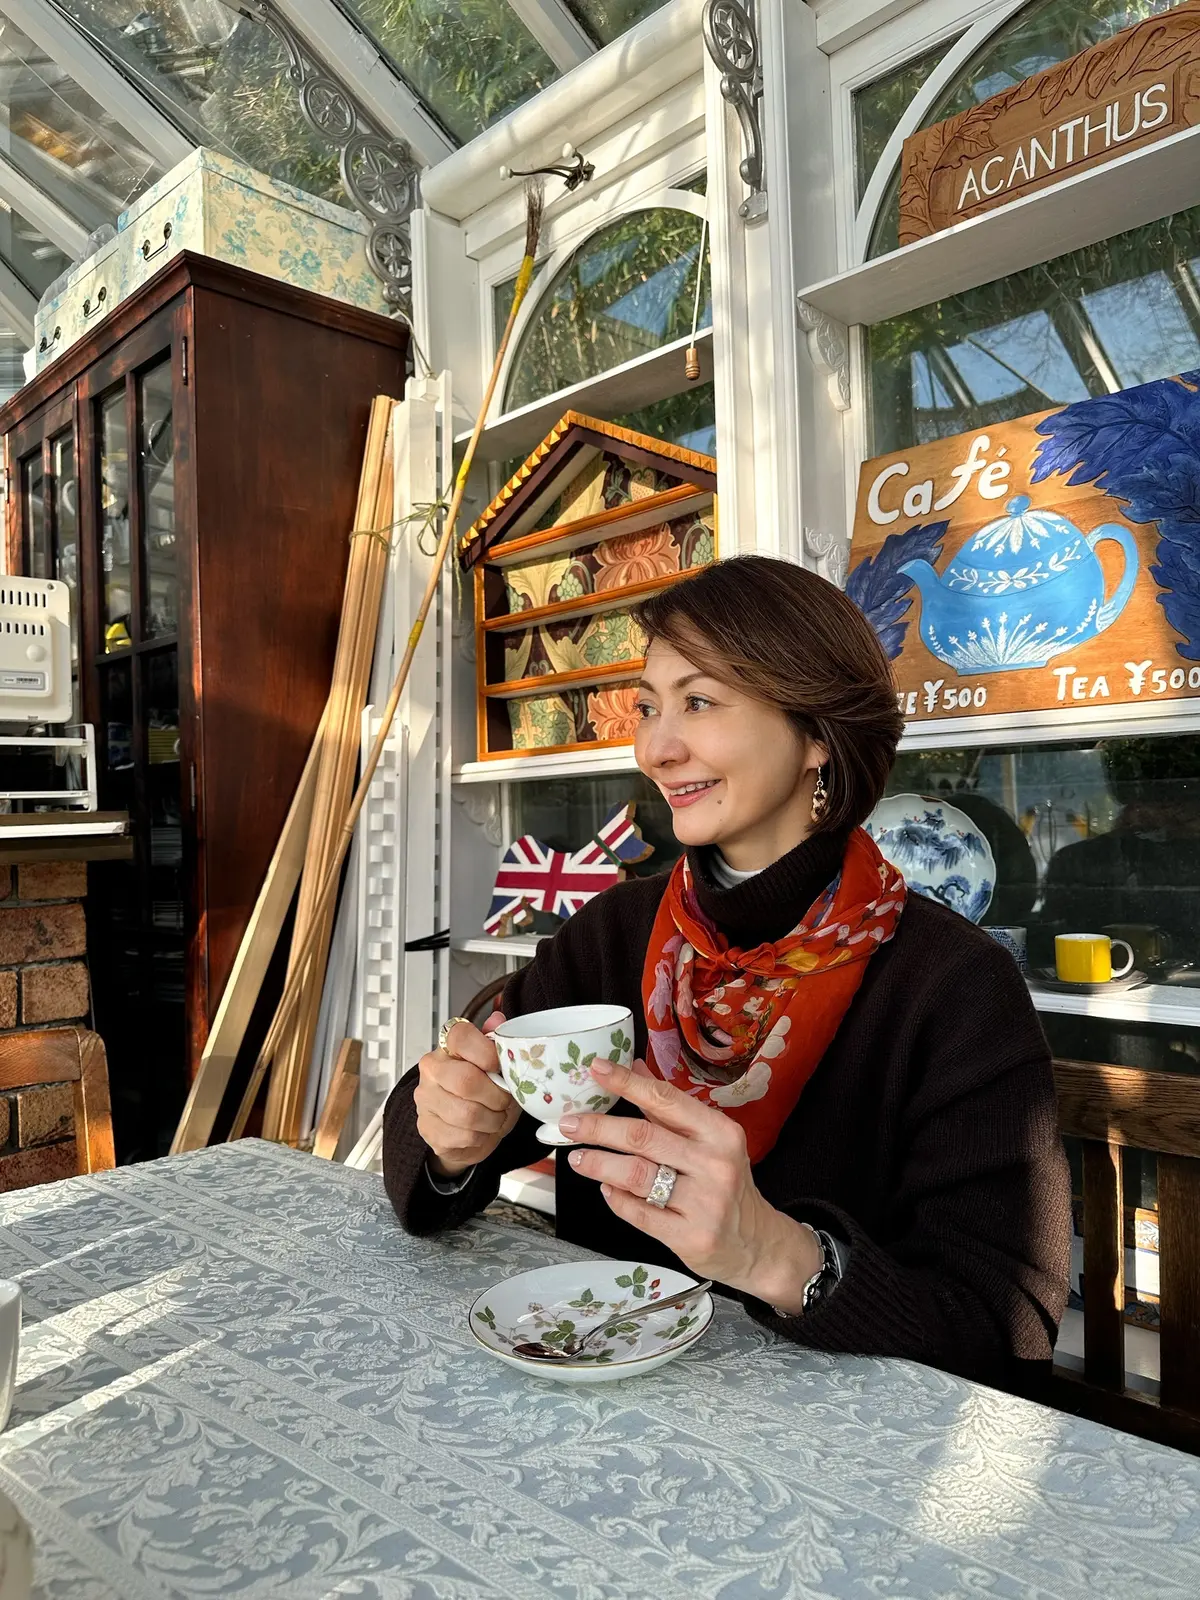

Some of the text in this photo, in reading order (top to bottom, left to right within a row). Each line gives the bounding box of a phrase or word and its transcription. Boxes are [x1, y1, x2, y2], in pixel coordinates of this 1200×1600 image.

[957, 83, 1168, 210] ACANTHUS
[867, 434, 1011, 525] Café
[923, 679, 987, 713] ¥500
[1052, 660, 1200, 701] TEA ¥500
